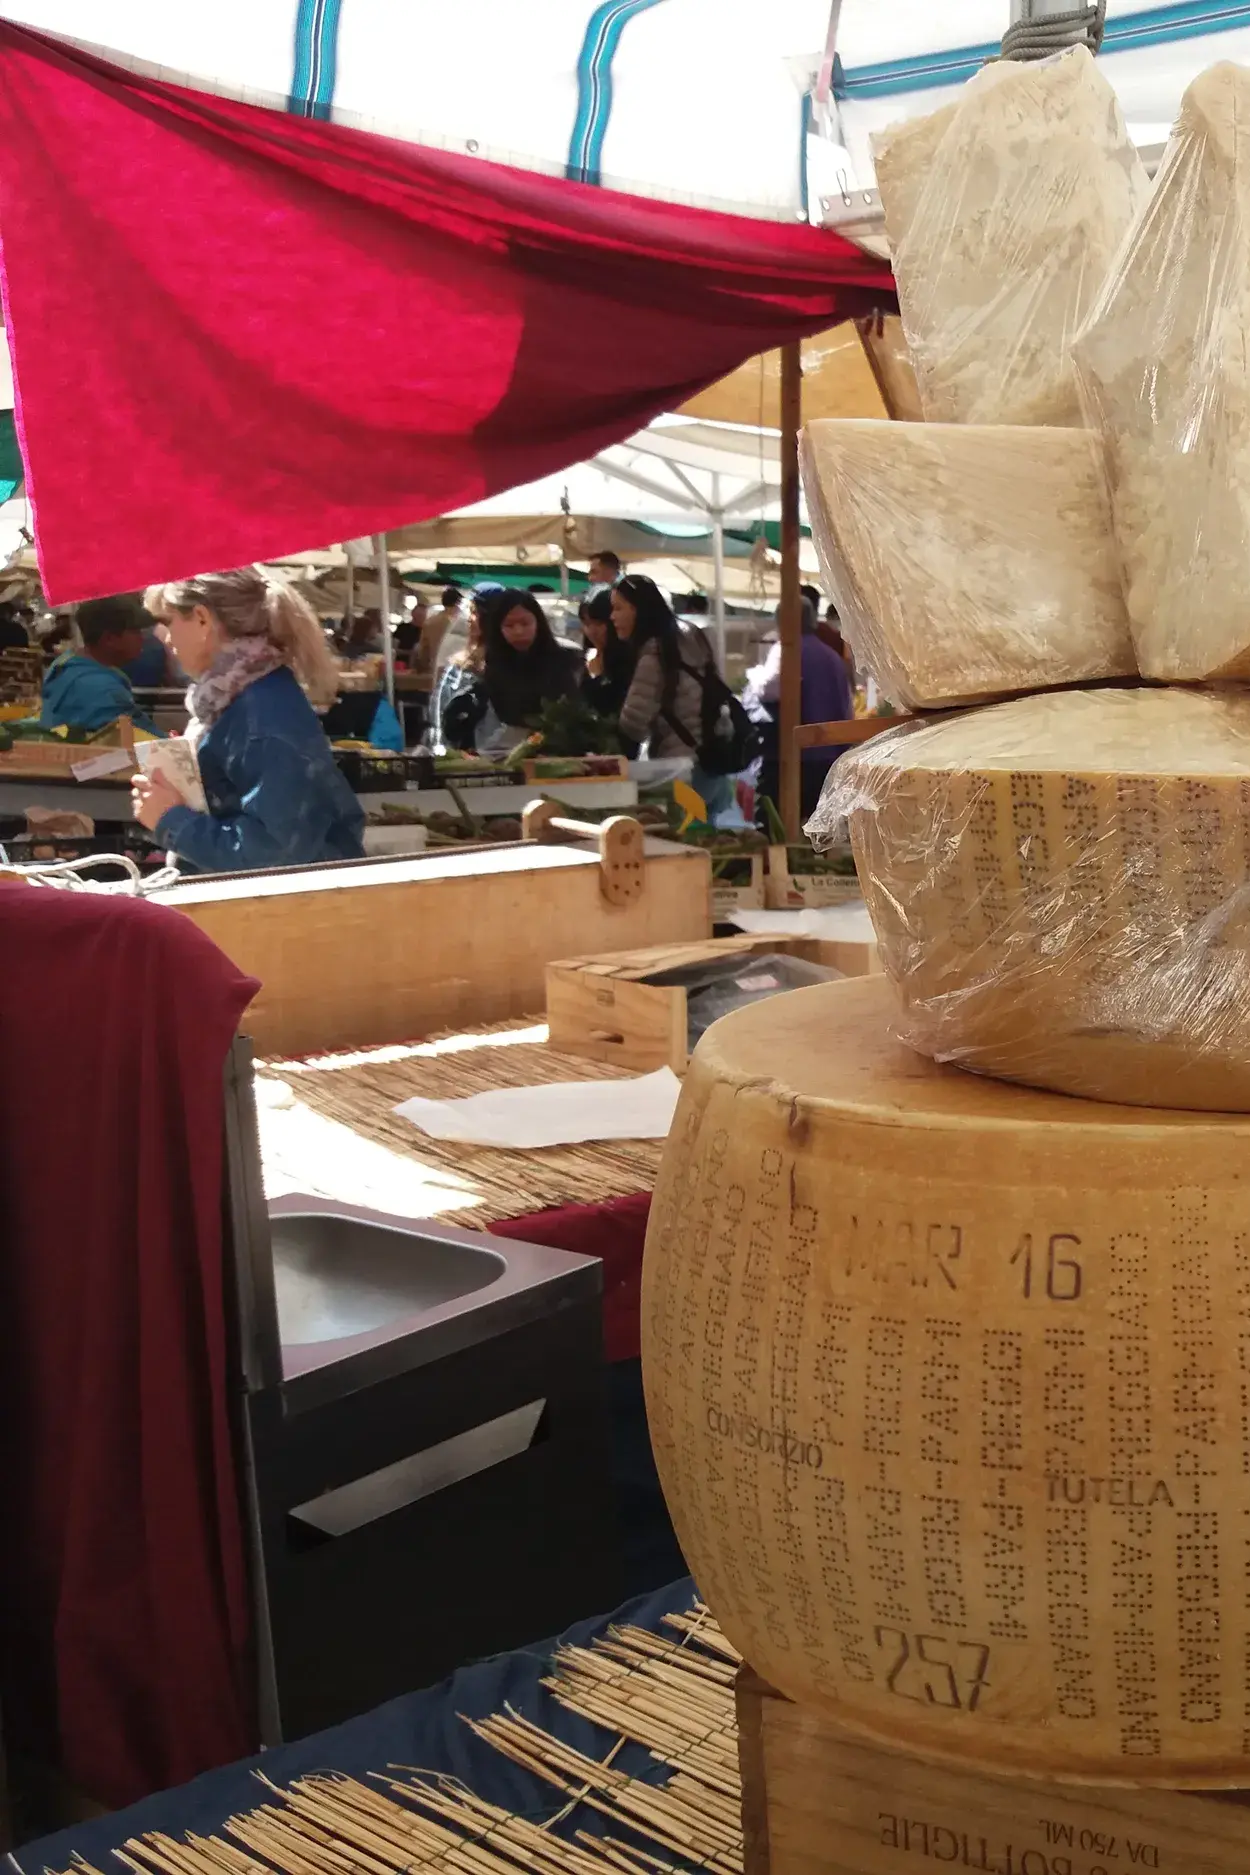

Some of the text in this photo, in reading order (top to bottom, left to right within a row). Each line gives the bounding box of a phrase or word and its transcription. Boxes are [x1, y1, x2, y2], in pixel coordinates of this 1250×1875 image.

[1009, 1232, 1083, 1301] 16
[1107, 1232, 1153, 1477] REGGIANO
[1168, 1184, 1218, 1477] PARMIGIANO
[707, 1406, 824, 1470] CONSORZIO
[1042, 1472, 1175, 1508] TUTELA
[873, 1624, 992, 1712] 257
[1046, 1506, 1098, 1720] REGGIANO
[1111, 1509, 1162, 1757] PARMIGIANO
[1176, 1511, 1222, 1724] REGGIANO
[1038, 1818, 1160, 1868] DA 750 ML
